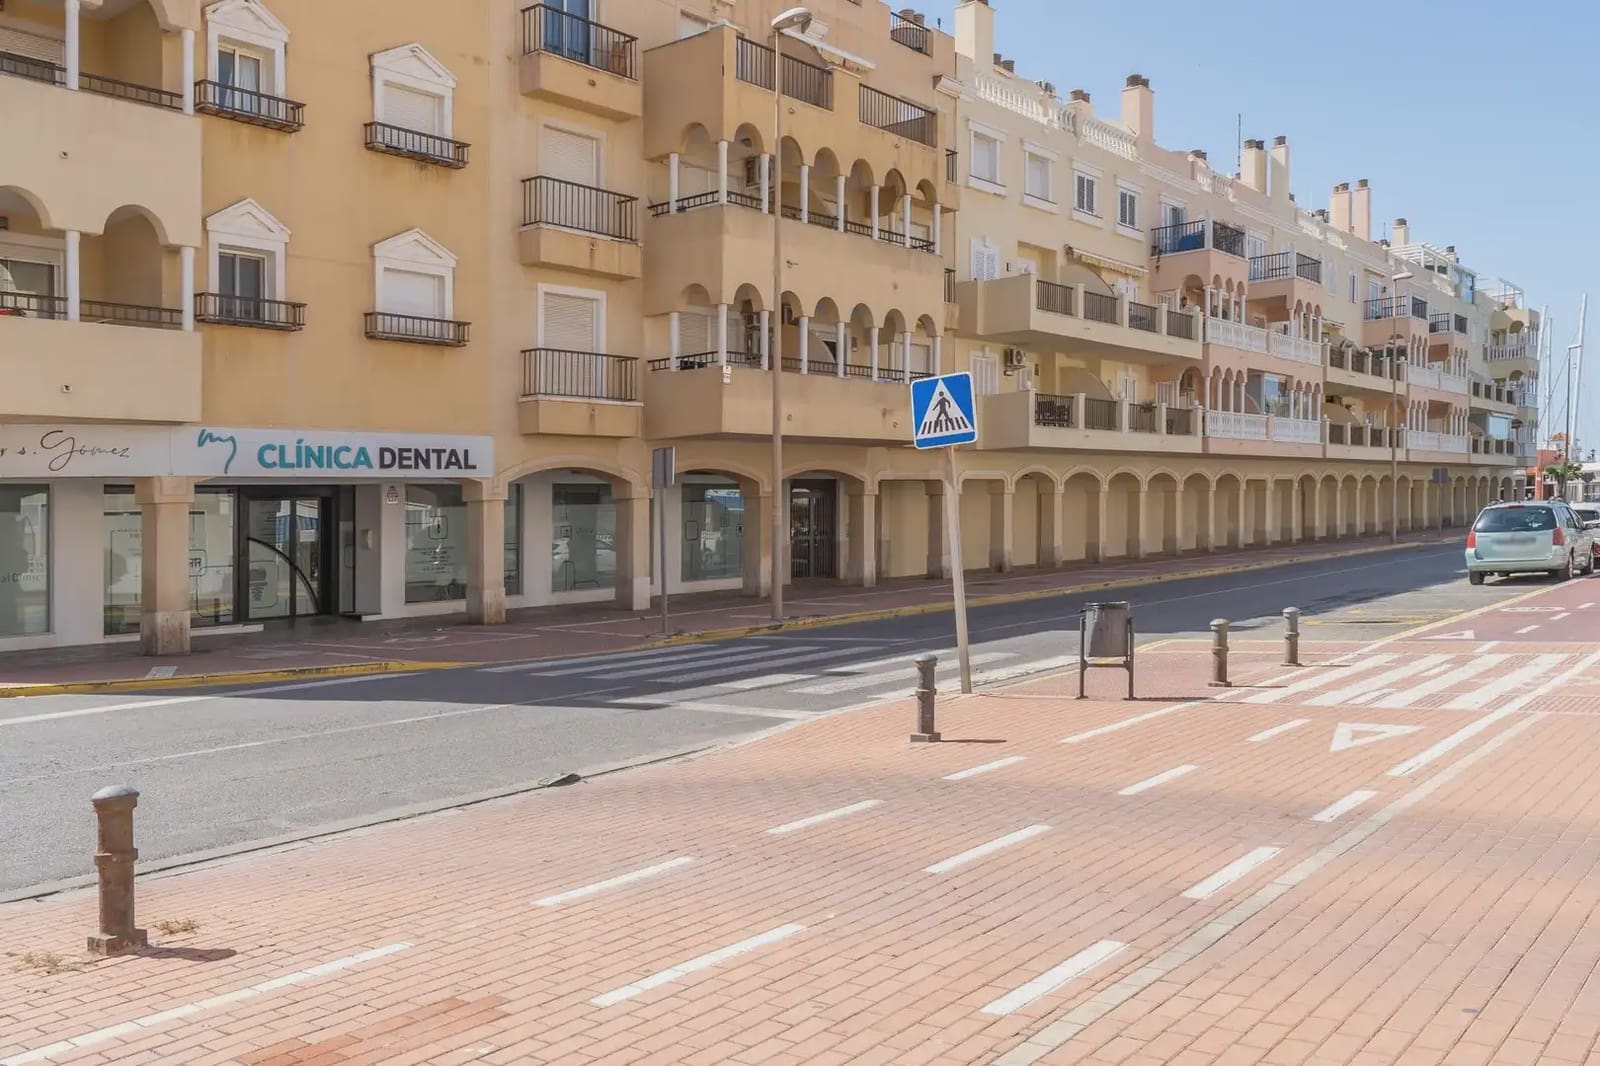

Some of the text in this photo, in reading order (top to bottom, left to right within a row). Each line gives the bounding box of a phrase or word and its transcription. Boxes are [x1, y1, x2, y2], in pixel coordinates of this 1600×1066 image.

[40, 429, 130, 472] Gómez
[256, 438, 478, 471] CLÍNICA DENTAL
